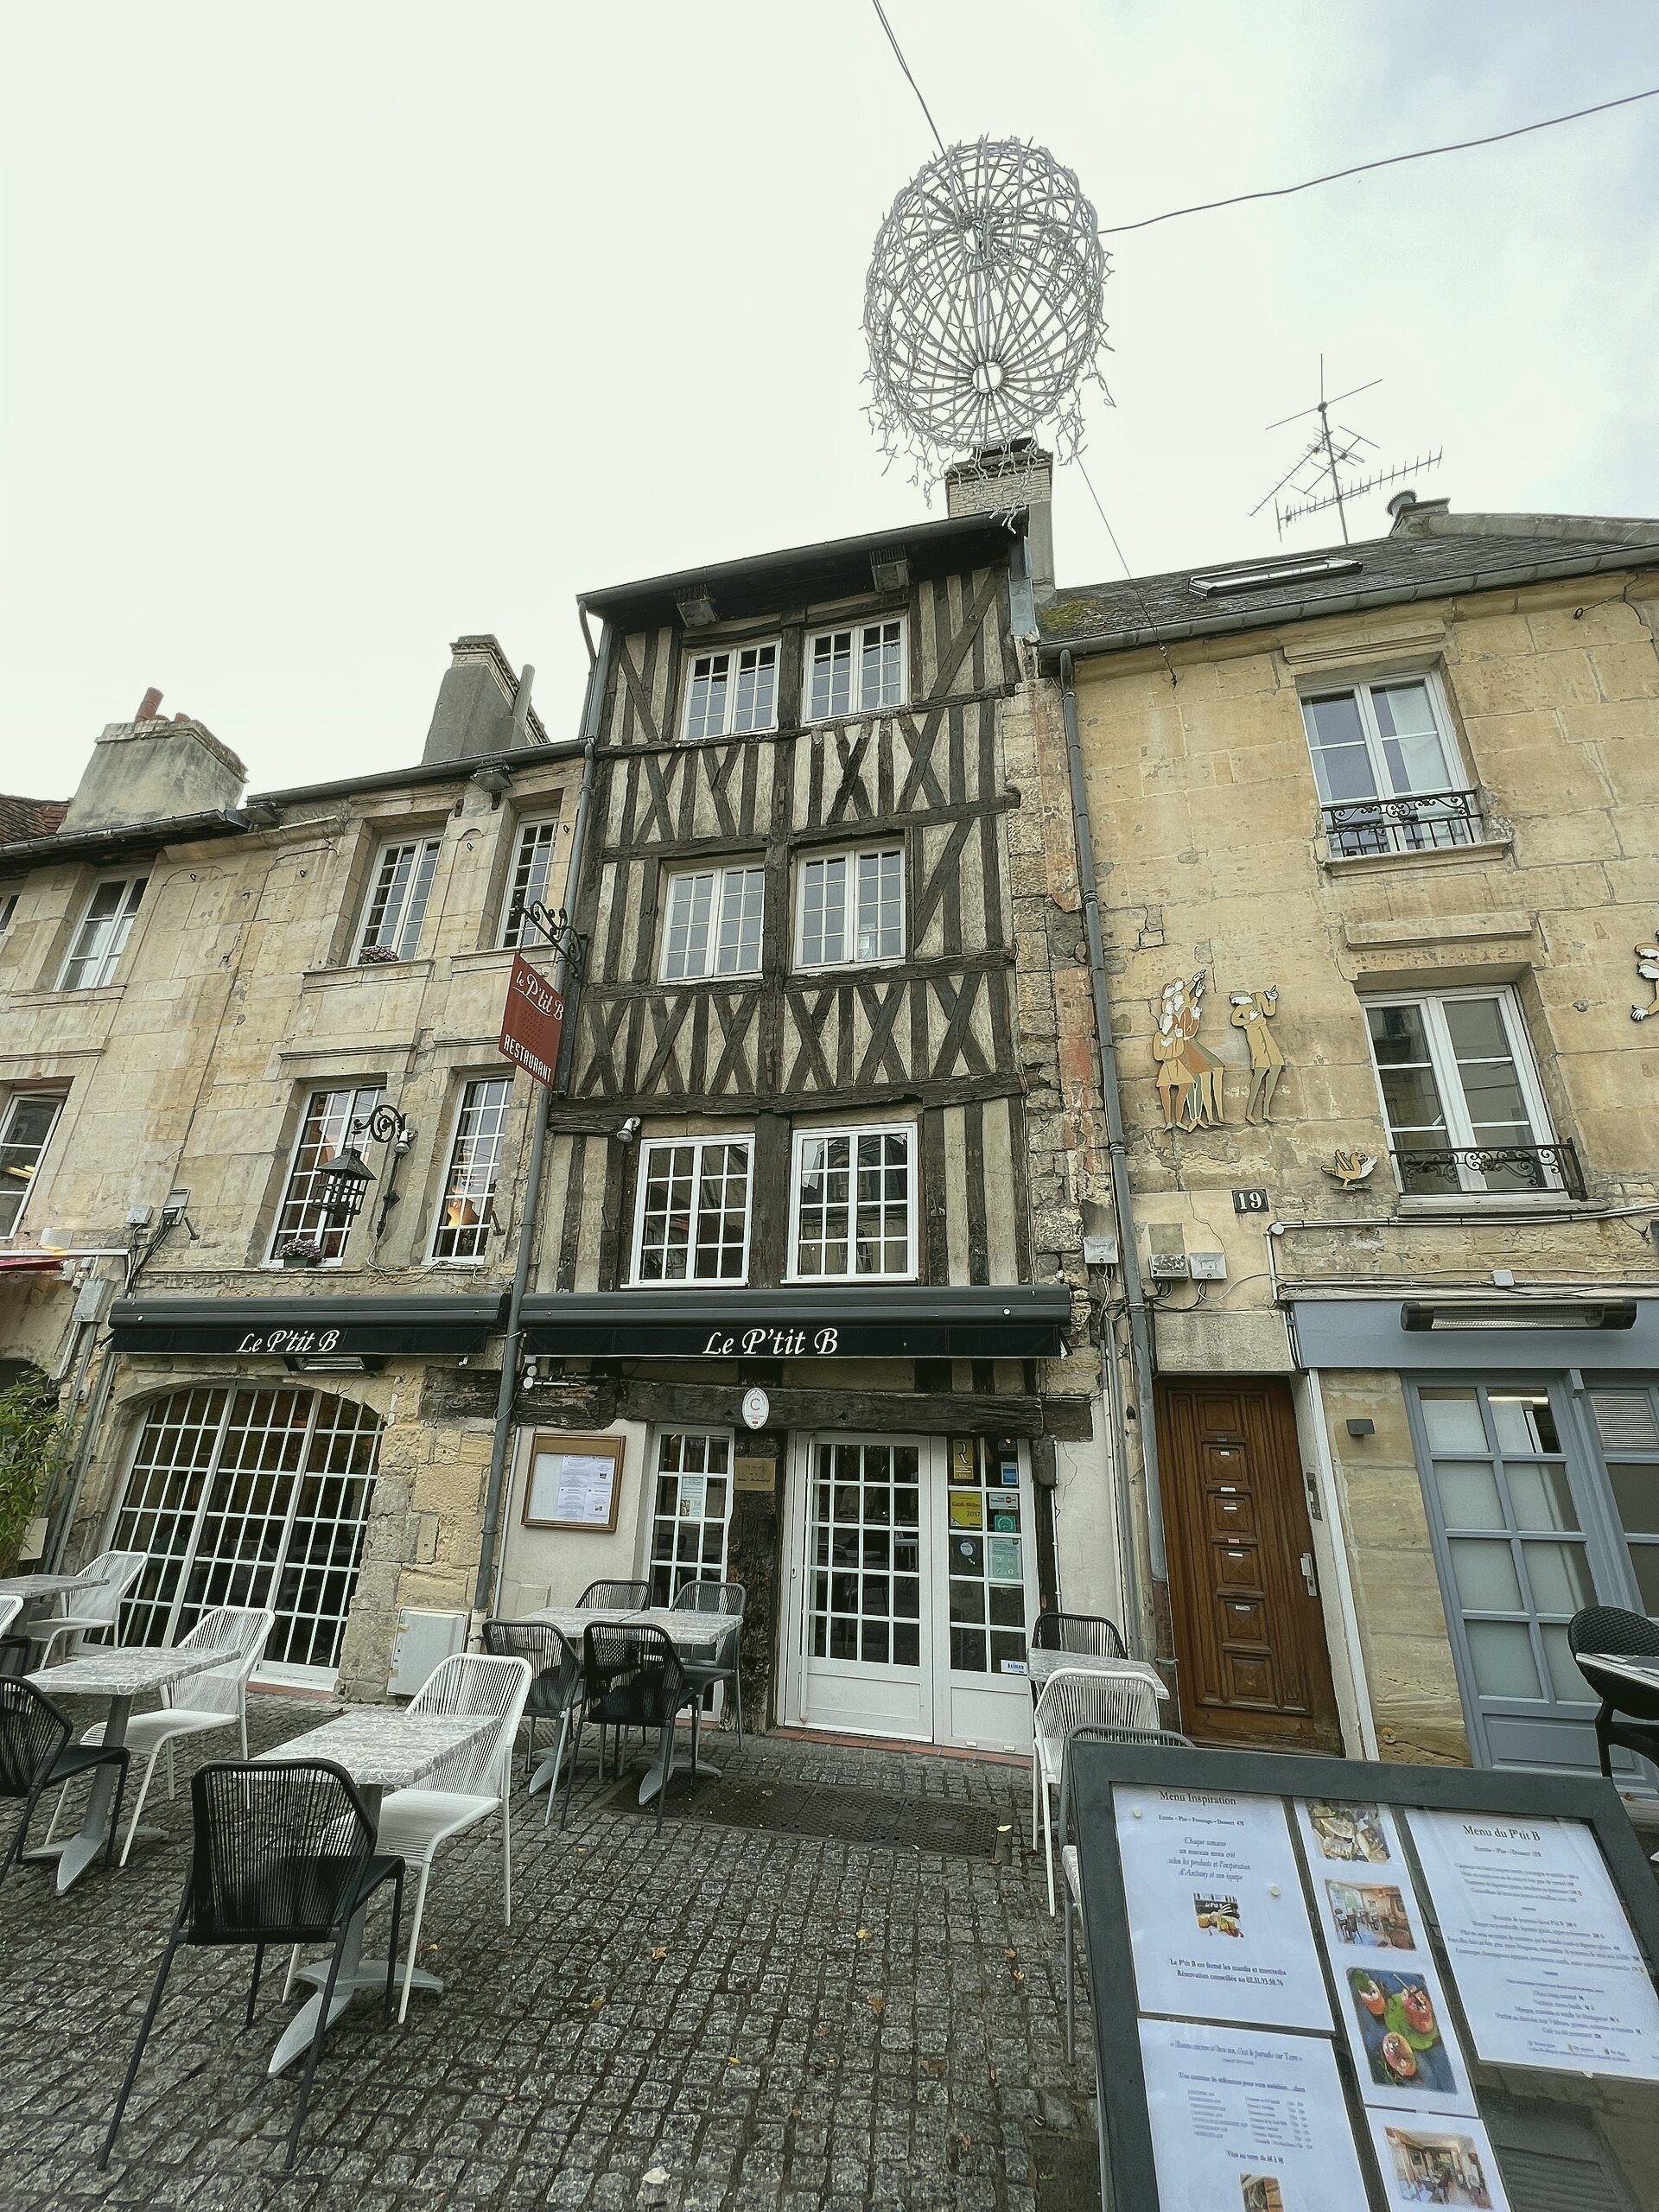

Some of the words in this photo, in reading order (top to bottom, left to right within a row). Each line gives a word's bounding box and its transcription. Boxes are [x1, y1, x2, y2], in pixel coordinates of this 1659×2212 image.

[516, 970, 525, 987] le
[523, 973, 553, 1013] P'tit
[553, 1000, 564, 1020] B
[504, 1033, 552, 1083] RESTAURANT
[1239, 1192, 1262, 1209] 19
[236, 1333, 263, 1352] Le
[266, 1330, 315, 1352] P'tit
[318, 1329, 340, 1352] B
[702, 1332, 734, 1355] Le
[741, 1328, 806, 1355] P'tit
[814, 1327, 839, 1355] B
[1160, 1790, 1185, 1802] Menu
[1188, 1793, 1236, 1806] Inspiration
[1463, 1825, 1492, 1836] Menu
[1495, 1827, 1507, 1838] du
[1510, 1829, 1530, 1840] P'tit
[1531, 1831, 1541, 1841] B
[1185, 1837, 1205, 1847] Chaque
[1177, 1969, 1209, 1980] Réservation
